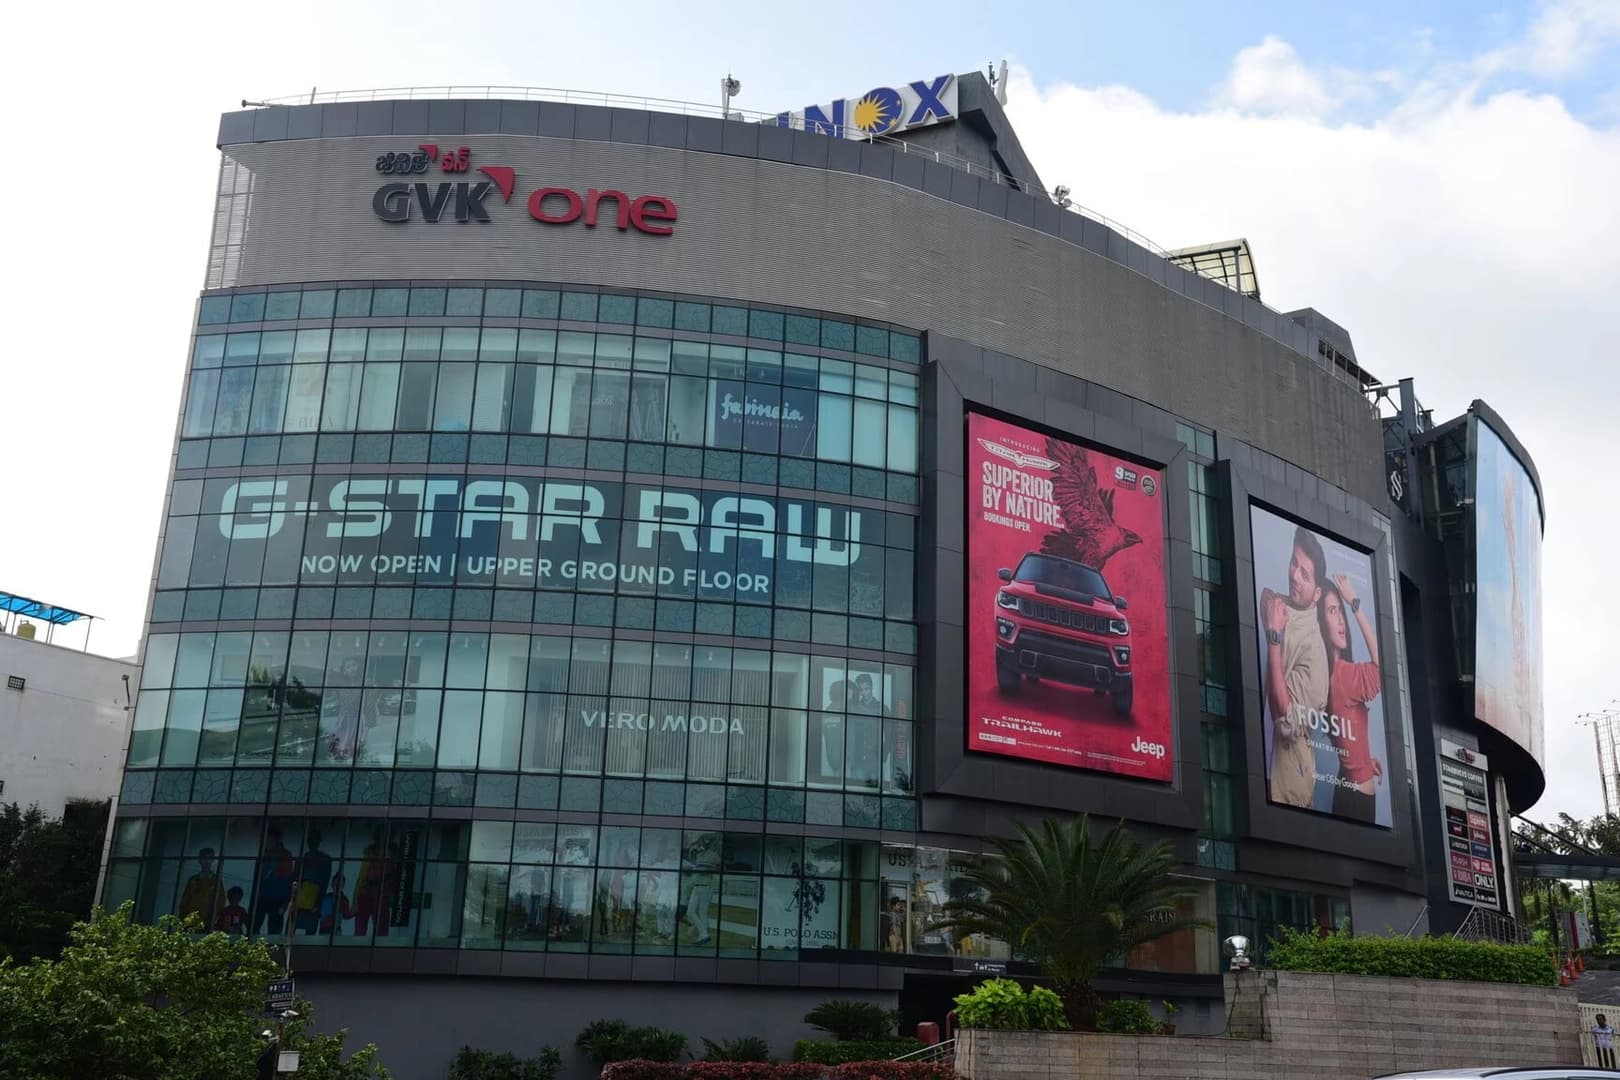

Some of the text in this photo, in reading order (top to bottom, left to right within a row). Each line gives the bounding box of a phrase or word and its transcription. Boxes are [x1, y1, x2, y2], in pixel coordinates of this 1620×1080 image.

[776, 73, 955, 139] INOX
[372, 182, 678, 236] GVK one
[983, 461, 1053, 503] SUPERIOR
[219, 479, 861, 567] G-STAR RAW
[983, 484, 1065, 529] BY NATURE.
[301, 554, 363, 574] NOW
[370, 554, 442, 574] OPEN
[467, 556, 552, 577] UPPER
[561, 560, 675, 585] GROUND
[683, 569, 769, 593] FLOOR
[581, 710, 744, 735] VERO MODA
[981, 717, 1062, 738] TRAILHAWK
[1131, 736, 1165, 759] Jeep
[1475, 874, 1494, 889] ONLY
